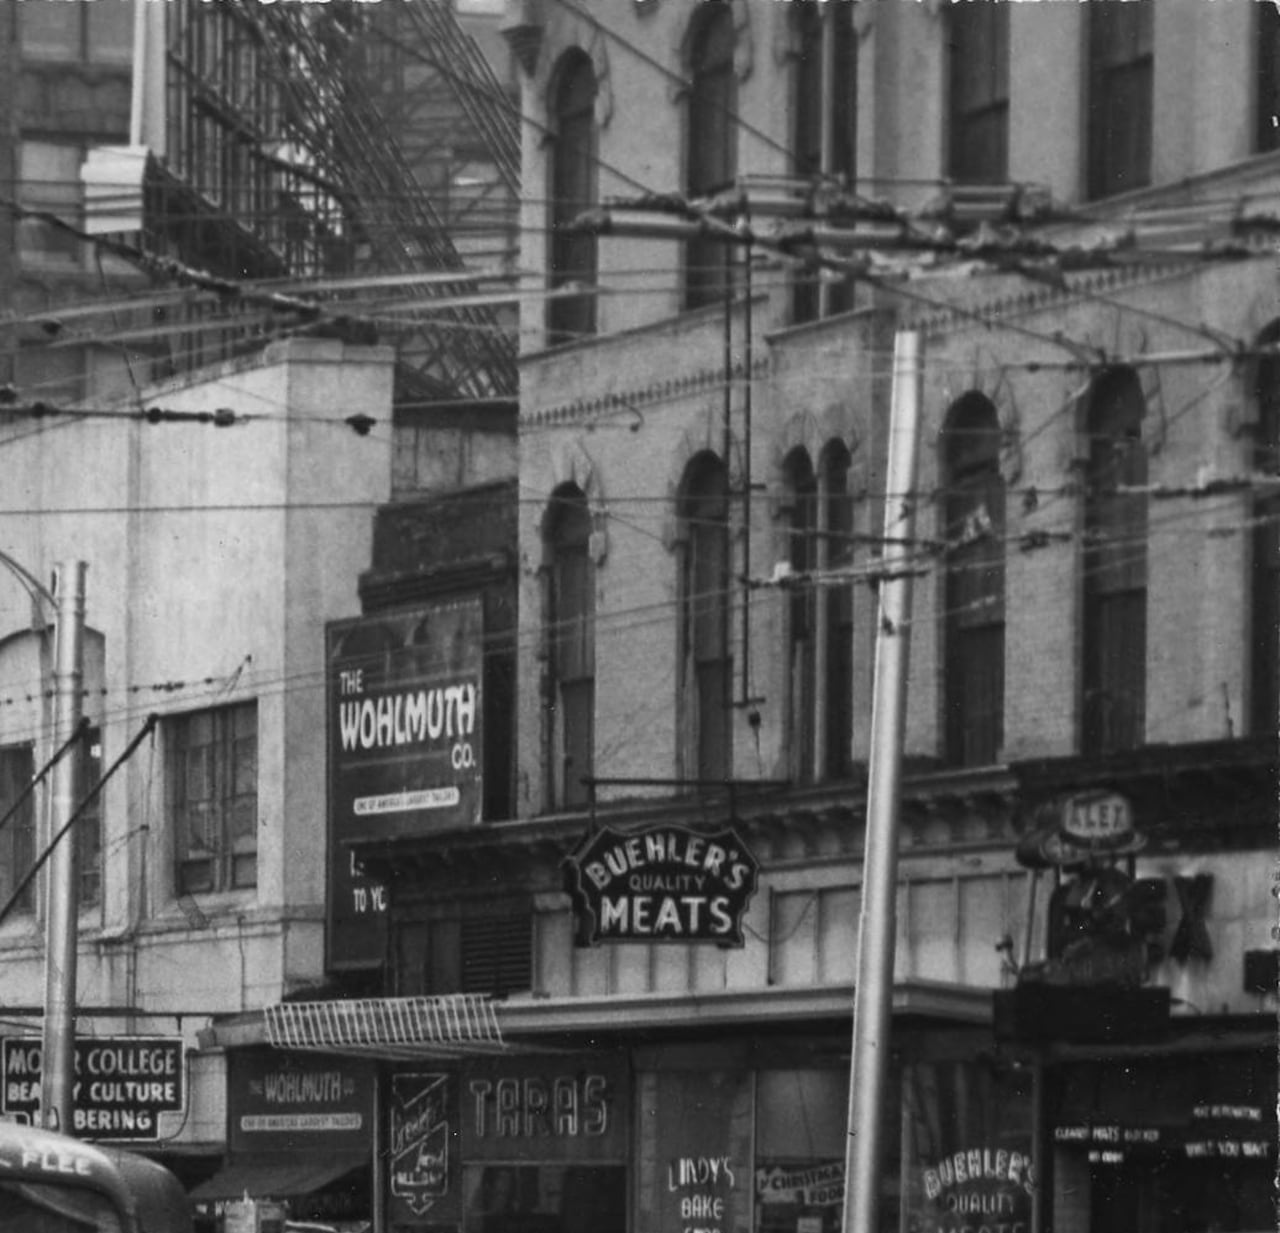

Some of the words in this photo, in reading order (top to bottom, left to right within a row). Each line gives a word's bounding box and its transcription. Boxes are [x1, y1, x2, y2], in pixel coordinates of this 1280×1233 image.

[340, 669, 364, 695] THE
[340, 682, 476, 751] WOHLMUTH
[451, 743, 476, 770] CO.
[585, 832, 749, 891] BUEHLER'S
[629, 874, 706, 892] QUALITY
[601, 897, 732, 935] MEATS
[8, 1048, 81, 1076] MOR
[88, 1048, 177, 1075] COLLEGE
[7, 1081, 81, 1102] BEAY
[91, 1081, 177, 1102] CULTURE
[265, 1071, 341, 1103] WOHLMUTH
[469, 1075, 607, 1137] TARAS
[1217, 1142, 1239, 1157] YOU
[668, 1156, 735, 1193] LINDY'S
[924, 1148, 1035, 1199] BUEHLER'S
[681, 1195, 726, 1220] BAKE
[946, 1192, 1014, 1214] QUALITY
